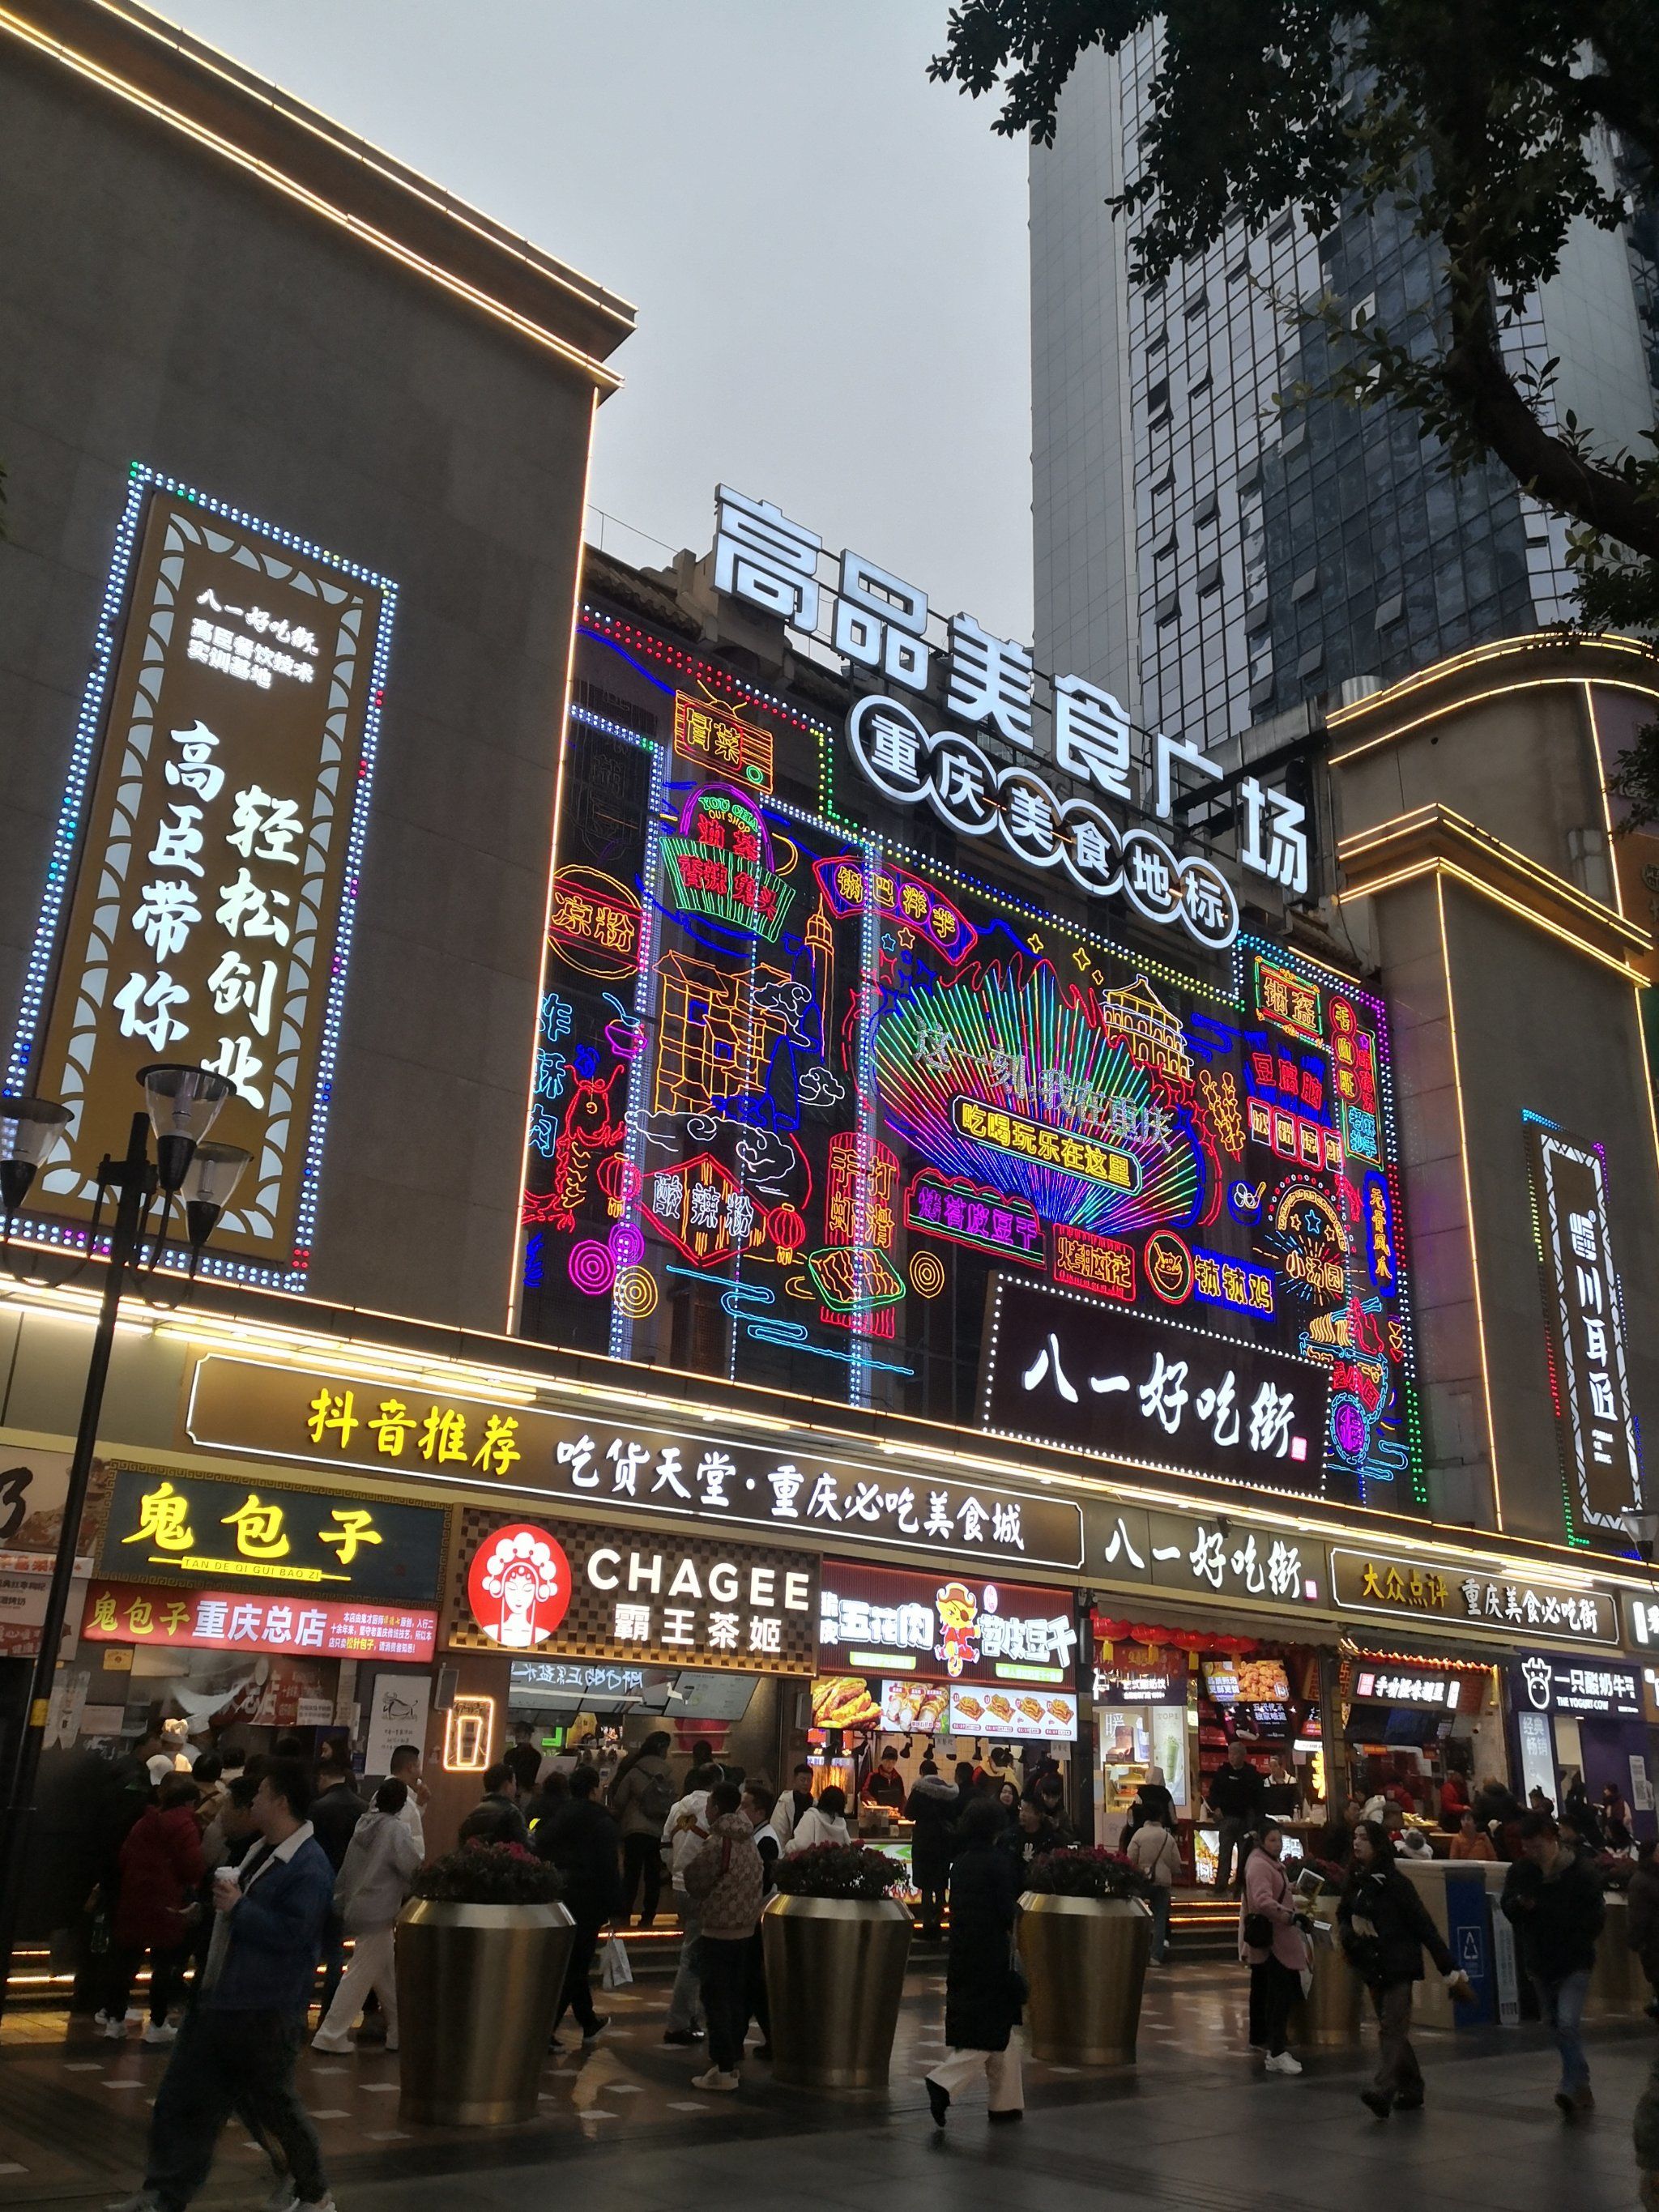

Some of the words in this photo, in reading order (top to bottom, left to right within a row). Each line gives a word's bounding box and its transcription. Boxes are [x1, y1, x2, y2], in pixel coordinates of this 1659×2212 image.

[196, 588, 314, 652] 八一好吃街
[187, 639, 272, 688] 实训基地
[713, 483, 1307, 893] 高品美食广场
[686, 708, 740, 764] 冒菜
[698, 797, 730, 811] YOU
[708, 810, 727, 820] OUT
[727, 813, 751, 833] SHOP
[869, 714, 1226, 931] 重庆美食地标
[697, 813, 760, 862] 油茶
[113, 719, 225, 1051] 高臣带你
[677, 854, 778, 922] 香辣兔头
[837, 866, 956, 938] 锅巴洋芋
[199, 784, 305, 1109] 轻松创业
[1264, 977, 1316, 1029] 锅盔
[1252, 1053, 1322, 1110] 豆腐脑
[831, 1147, 897, 1200] 手打
[961, 1102, 1132, 1187] 吃喝玩乐在这里
[653, 1172, 754, 1237] 酸辣粉
[830, 1191, 895, 1248] 虾滑
[1370, 1187, 1392, 1279] 无骨凤爪
[1058, 1237, 1132, 1288] 烤脑花
[1194, 1255, 1274, 1313] 钵钵鸡
[1286, 1250, 1344, 1293] 小汤圆
[1022, 1333, 1295, 1458] 八一好吃街
[307, 1387, 521, 1476] 抖音推荐
[122, 1481, 383, 1565] 鬼包子
[185, 1558, 209, 1570] TAN
[215, 1562, 229, 1571] DE
[236, 1564, 248, 1573] QI
[253, 1566, 275, 1575] GUI
[279, 1568, 304, 1579] BAO
[309, 1571, 319, 1580] ZI
[587, 1548, 809, 1610] CHAGEE
[1105, 1518, 1300, 1598] 八一好吃街
[86, 1591, 191, 1636] 鬼包子
[192, 1600, 328, 1647] 重庆总店
[1363, 1563, 1449, 1608] 大众点评
[1461, 1579, 1597, 1634] 重庆美食必吃街
[614, 1603, 782, 1653] 霸王茶姬
[1554, 1669, 1626, 1698] 一只酸奶牛
[1556, 1696, 1568, 1707] THE
[1593, 1700, 1610, 1711] COW
